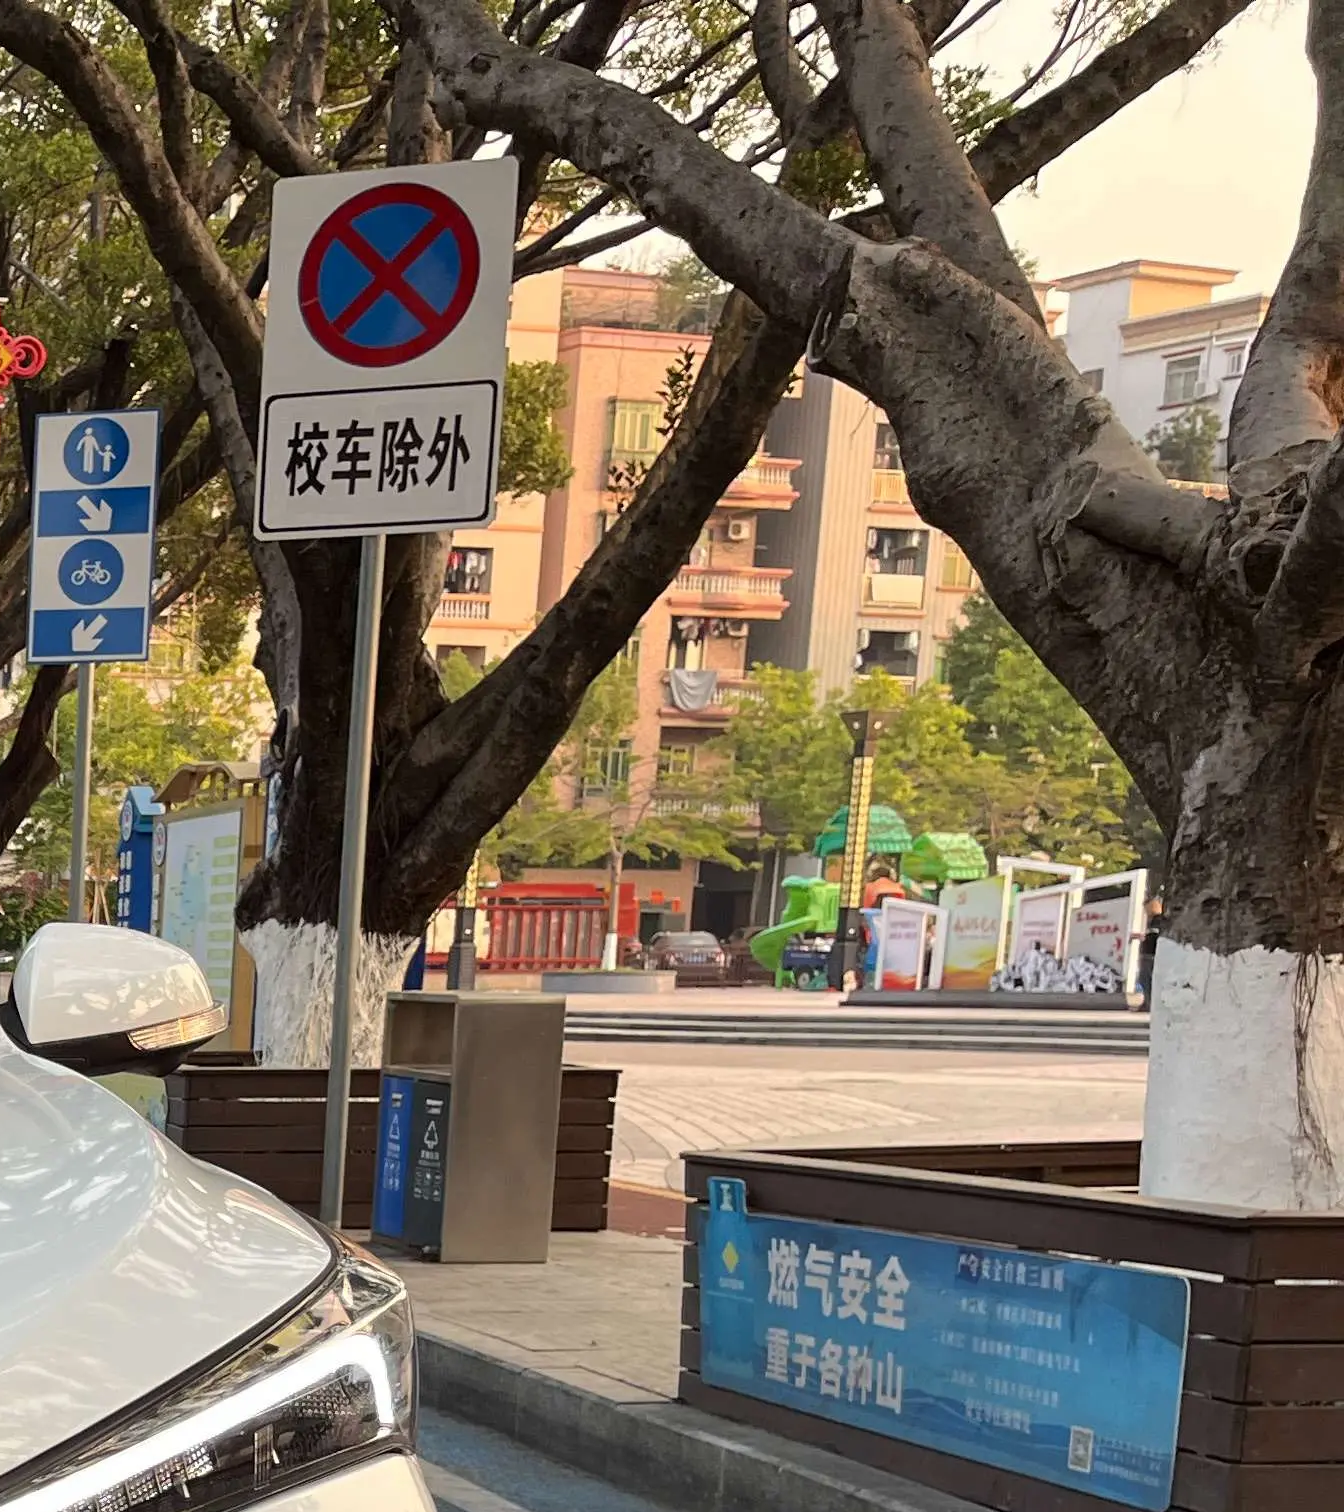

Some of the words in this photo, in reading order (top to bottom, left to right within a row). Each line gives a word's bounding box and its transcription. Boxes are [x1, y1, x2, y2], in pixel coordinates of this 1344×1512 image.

[284, 414, 471, 496] 校车除外
[767, 1237, 911, 1331] 燃气安全
